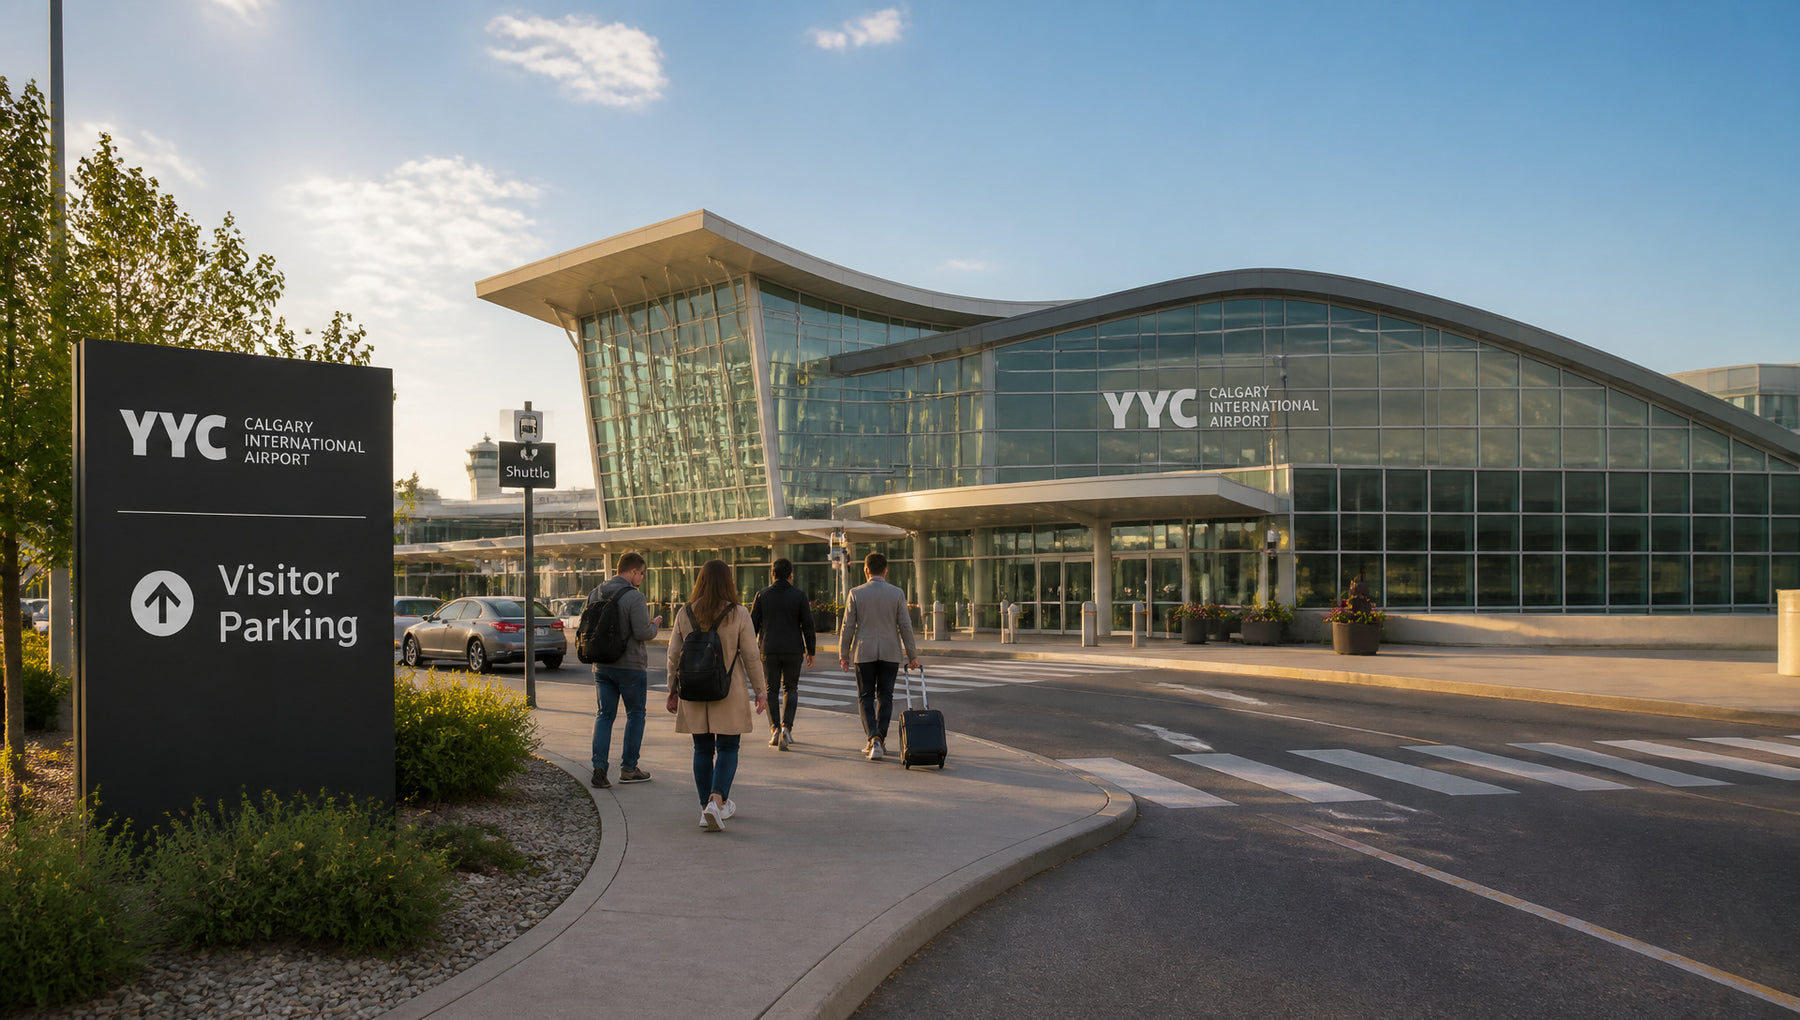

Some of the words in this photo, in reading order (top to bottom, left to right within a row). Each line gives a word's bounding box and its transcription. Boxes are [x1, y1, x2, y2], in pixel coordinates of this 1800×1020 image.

[1209, 385, 1270, 399] CALGARY
[1103, 388, 1198, 430] YYC
[1209, 399, 1320, 413] INTERNATIONAL
[244, 417, 314, 434] CALGARY
[1209, 415, 1269, 428] AIRPORT
[119, 409, 227, 461] YYC
[244, 433, 366, 454] INTERNATIONAL
[244, 450, 311, 466] AIRPORT
[217, 563, 340, 596] Visitor
[220, 608, 358, 647] Parking
